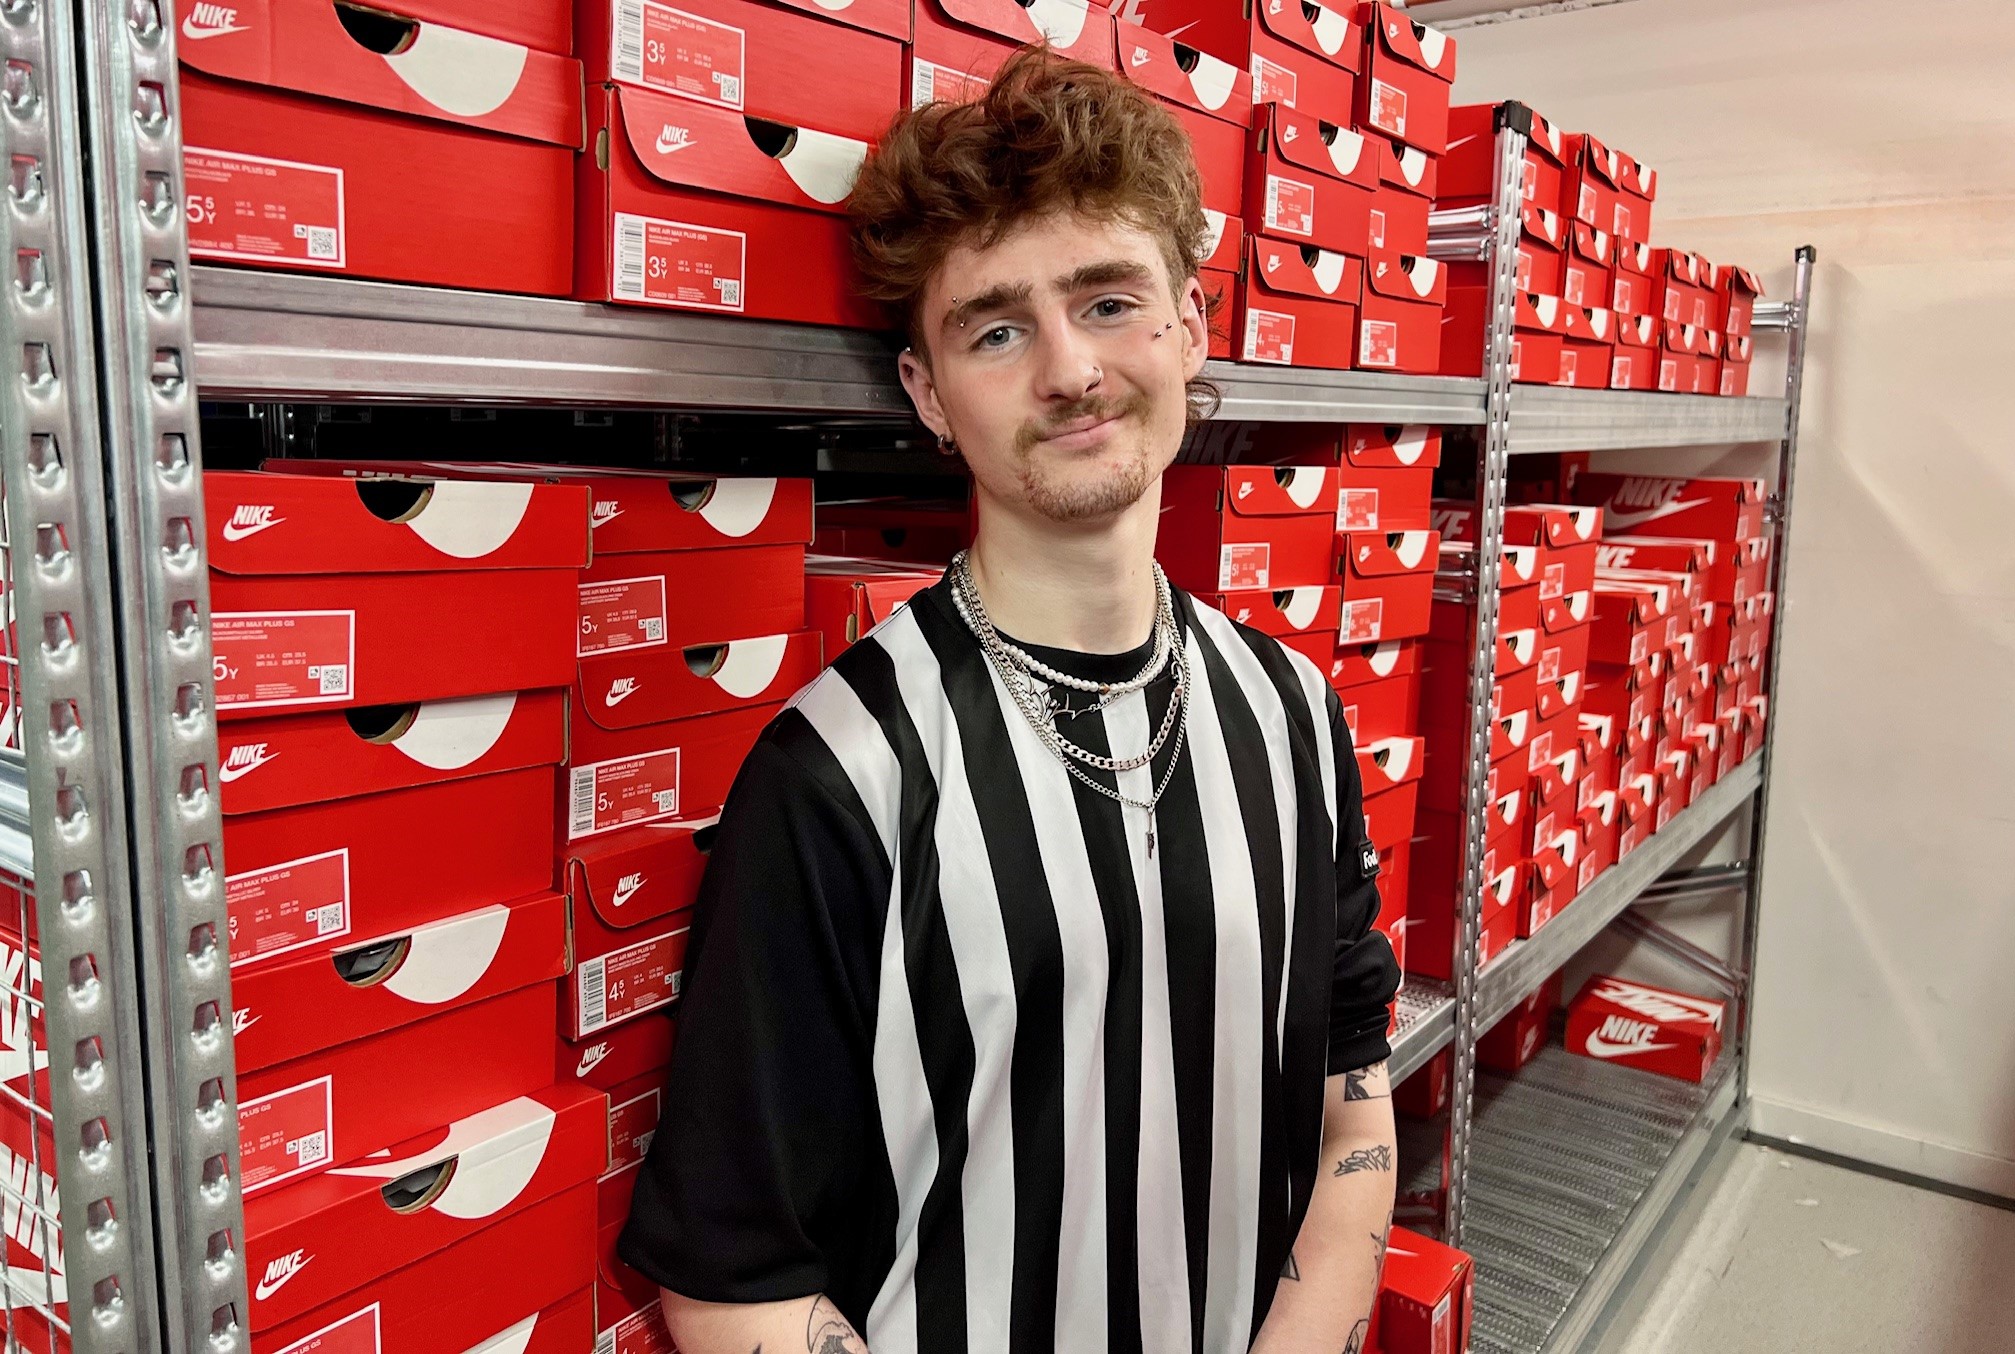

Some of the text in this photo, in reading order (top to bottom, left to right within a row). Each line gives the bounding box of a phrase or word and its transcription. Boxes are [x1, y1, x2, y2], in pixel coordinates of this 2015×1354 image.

[192, 2, 237, 28] NIKE
[647, 40, 658, 62] 3
[662, 124, 689, 144] NIKE
[206, 159, 220, 168] AIR
[222, 162, 241, 171] MAX
[242, 164, 264, 176] PLUS
[186, 195, 204, 223] 5
[206, 212, 216, 224] Y
[648, 256, 660, 278] 3
[661, 269, 667, 279] Y
[1614, 478, 1686, 507] NIKE
[232, 505, 274, 525] NIKE
[594, 501, 618, 516] NIKE
[611, 677, 635, 694] NIKE
[228, 743, 268, 767] NIKE
[244, 879, 259, 888] MAX
[261, 875, 279, 884] PLUS
[618, 872, 641, 894] NIKE
[230, 929, 238, 940] Y
[608, 982, 619, 1001] 4
[619, 989, 625, 998] Y
[1600, 1014, 1659, 1045] NIKE
[582, 1042, 607, 1064] NIKE
[240, 1107, 259, 1119] PLUS
[264, 1248, 304, 1283] NIKE
[310, 1339, 321, 1348] GS
